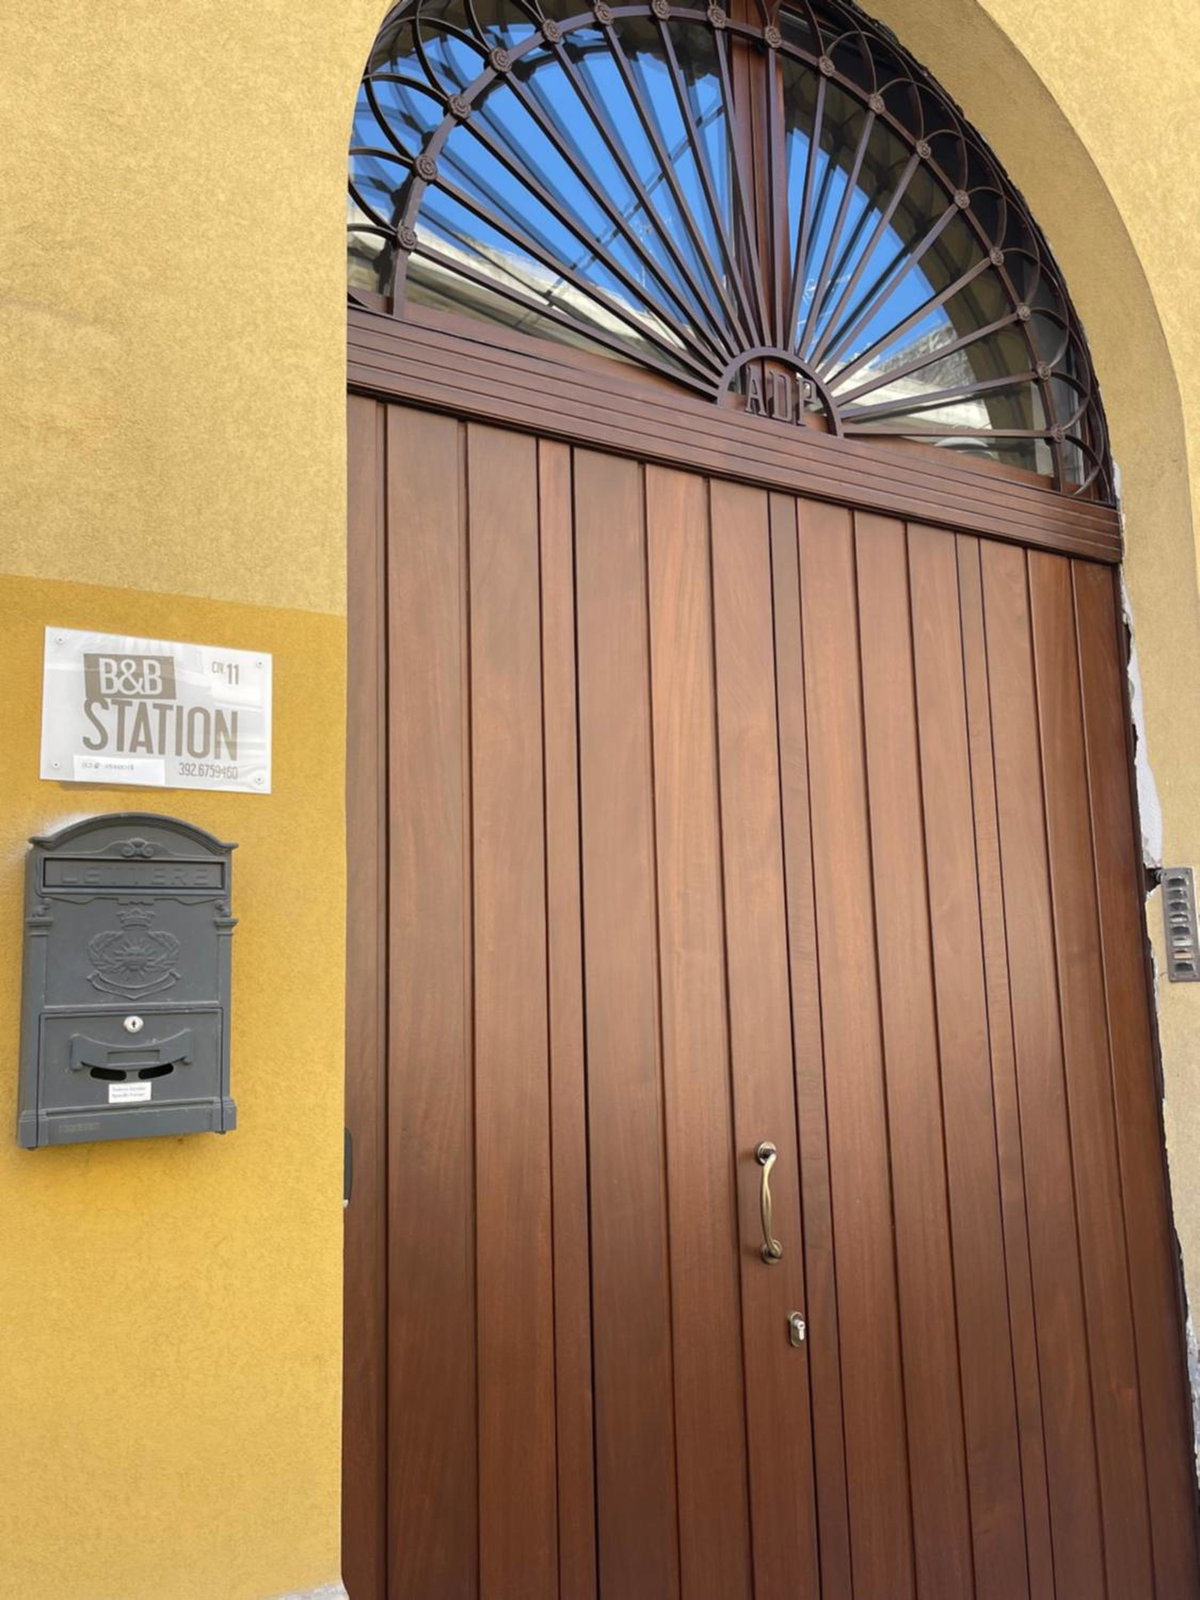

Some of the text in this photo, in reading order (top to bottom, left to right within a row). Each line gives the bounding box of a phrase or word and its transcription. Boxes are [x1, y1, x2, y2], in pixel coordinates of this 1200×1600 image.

[99, 657, 163, 695] B&B
[226, 663, 240, 685] 11
[82, 698, 239, 761] STATION
[61, 866, 210, 886] LETTERE
